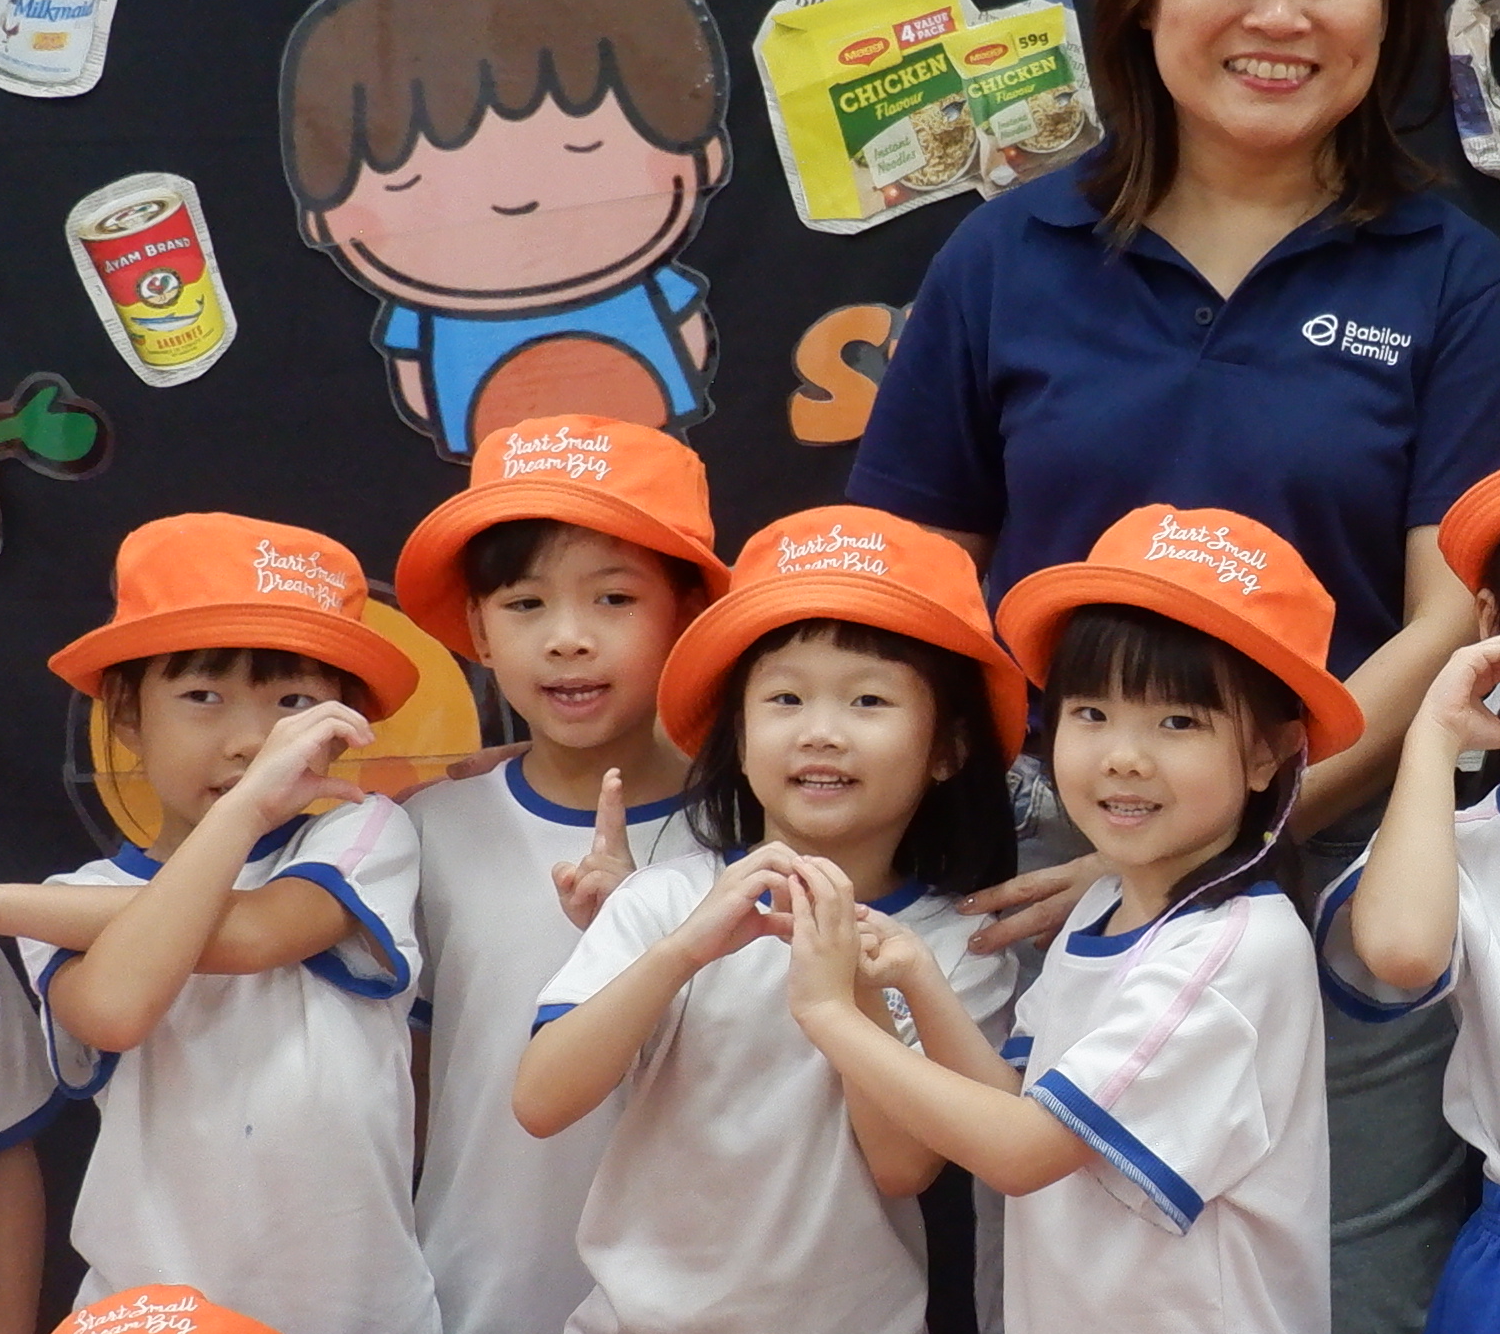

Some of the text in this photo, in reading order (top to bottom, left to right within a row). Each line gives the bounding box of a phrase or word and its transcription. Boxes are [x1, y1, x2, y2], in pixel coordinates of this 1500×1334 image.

[900, 23, 916, 43] 4
[915, 11, 950, 30] VALUE
[917, 22, 947, 41] PACK
[1018, 31, 1050, 51] 59g
[839, 52, 948, 114] CHICKEN
[967, 55, 1058, 98] CHICKEN
[875, 90, 924, 120] Flavour
[996, 84, 1035, 105] Flavour
[874, 136, 911, 157] Instant
[104, 237, 191, 274] AYAM BRAND
[156, 326, 203, 349] SARDINES
[1345, 321, 1412, 348] Babilou
[1340, 338, 1399, 365] Family
[503, 427, 612, 462] Start Small
[506, 453, 612, 480] Dream Big
[777, 524, 886, 563] Start Small
[1152, 514, 1267, 569] Start Small
[1148, 537, 1262, 596] Dream Big
[74, 1295, 197, 1328] Start Small
